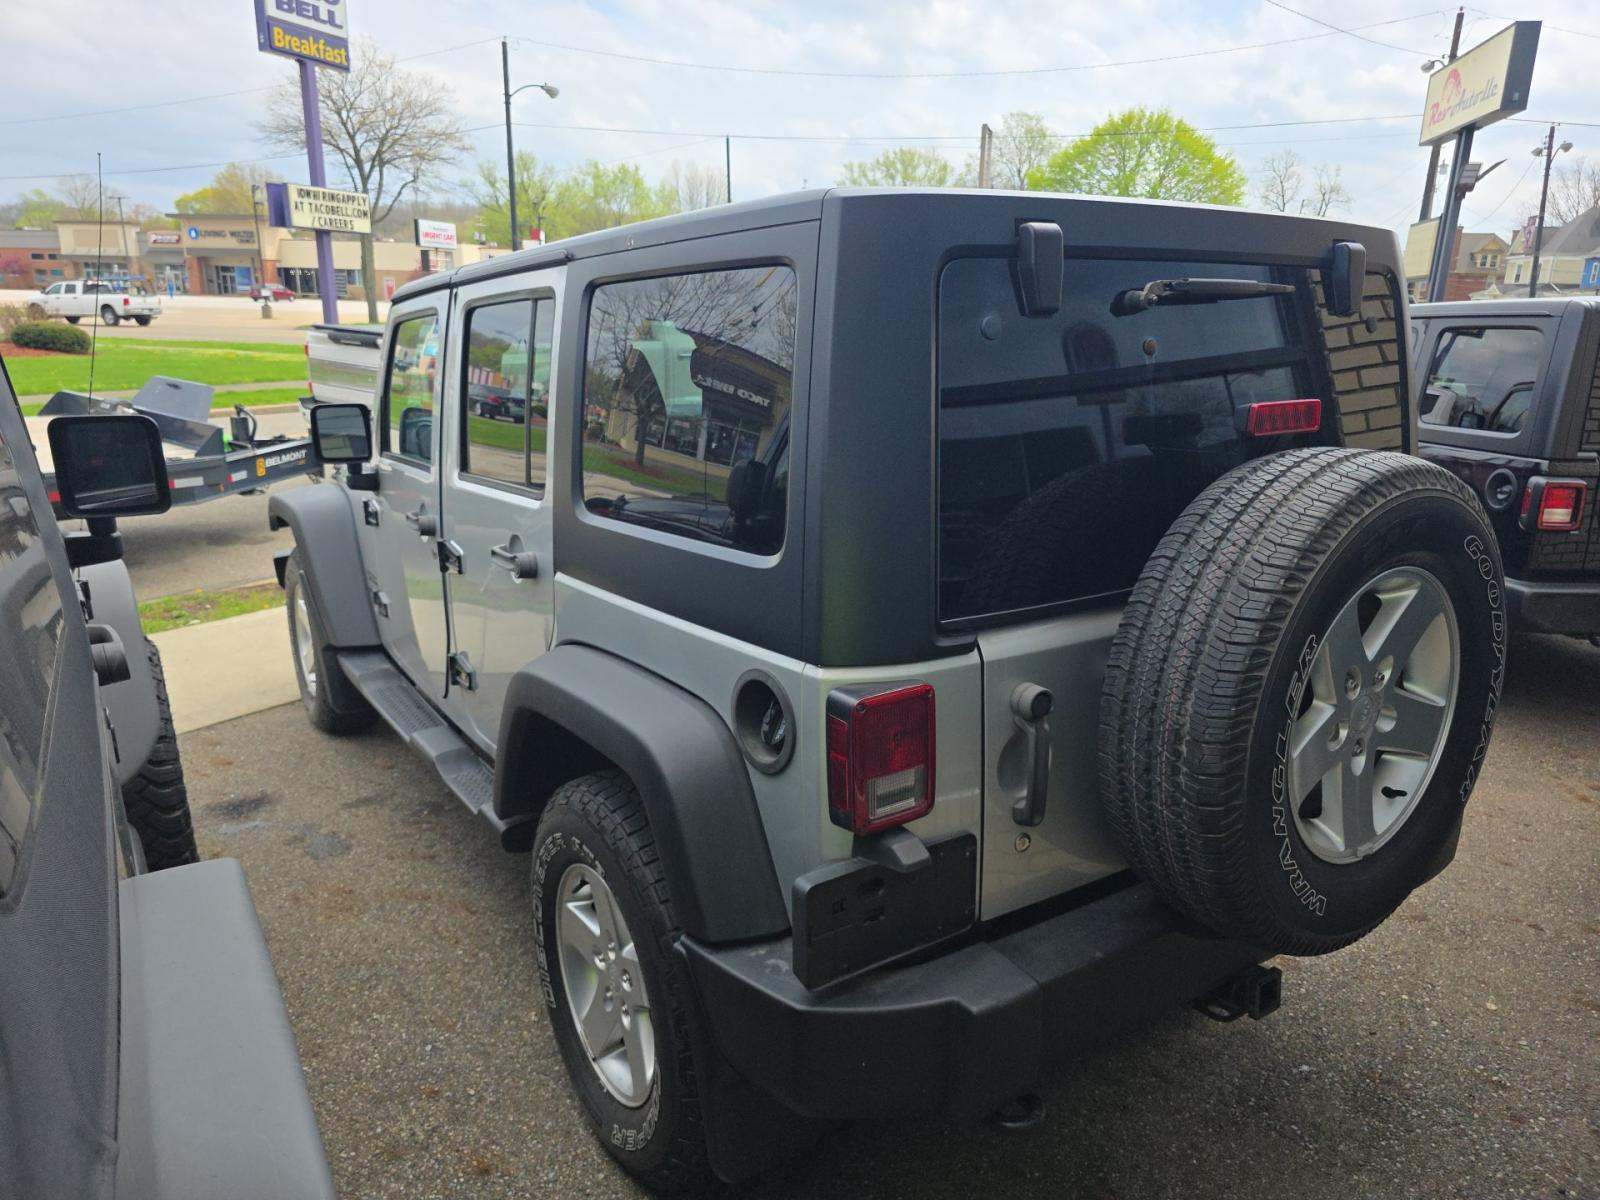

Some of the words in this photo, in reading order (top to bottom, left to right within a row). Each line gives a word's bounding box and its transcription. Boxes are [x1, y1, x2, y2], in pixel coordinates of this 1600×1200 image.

[273, 27, 347, 64] Breakfast
[266, 449, 308, 467] BELMONT
[1463, 535, 1506, 801] GOODYEAR
[1271, 634, 1327, 916] WRANGLER
